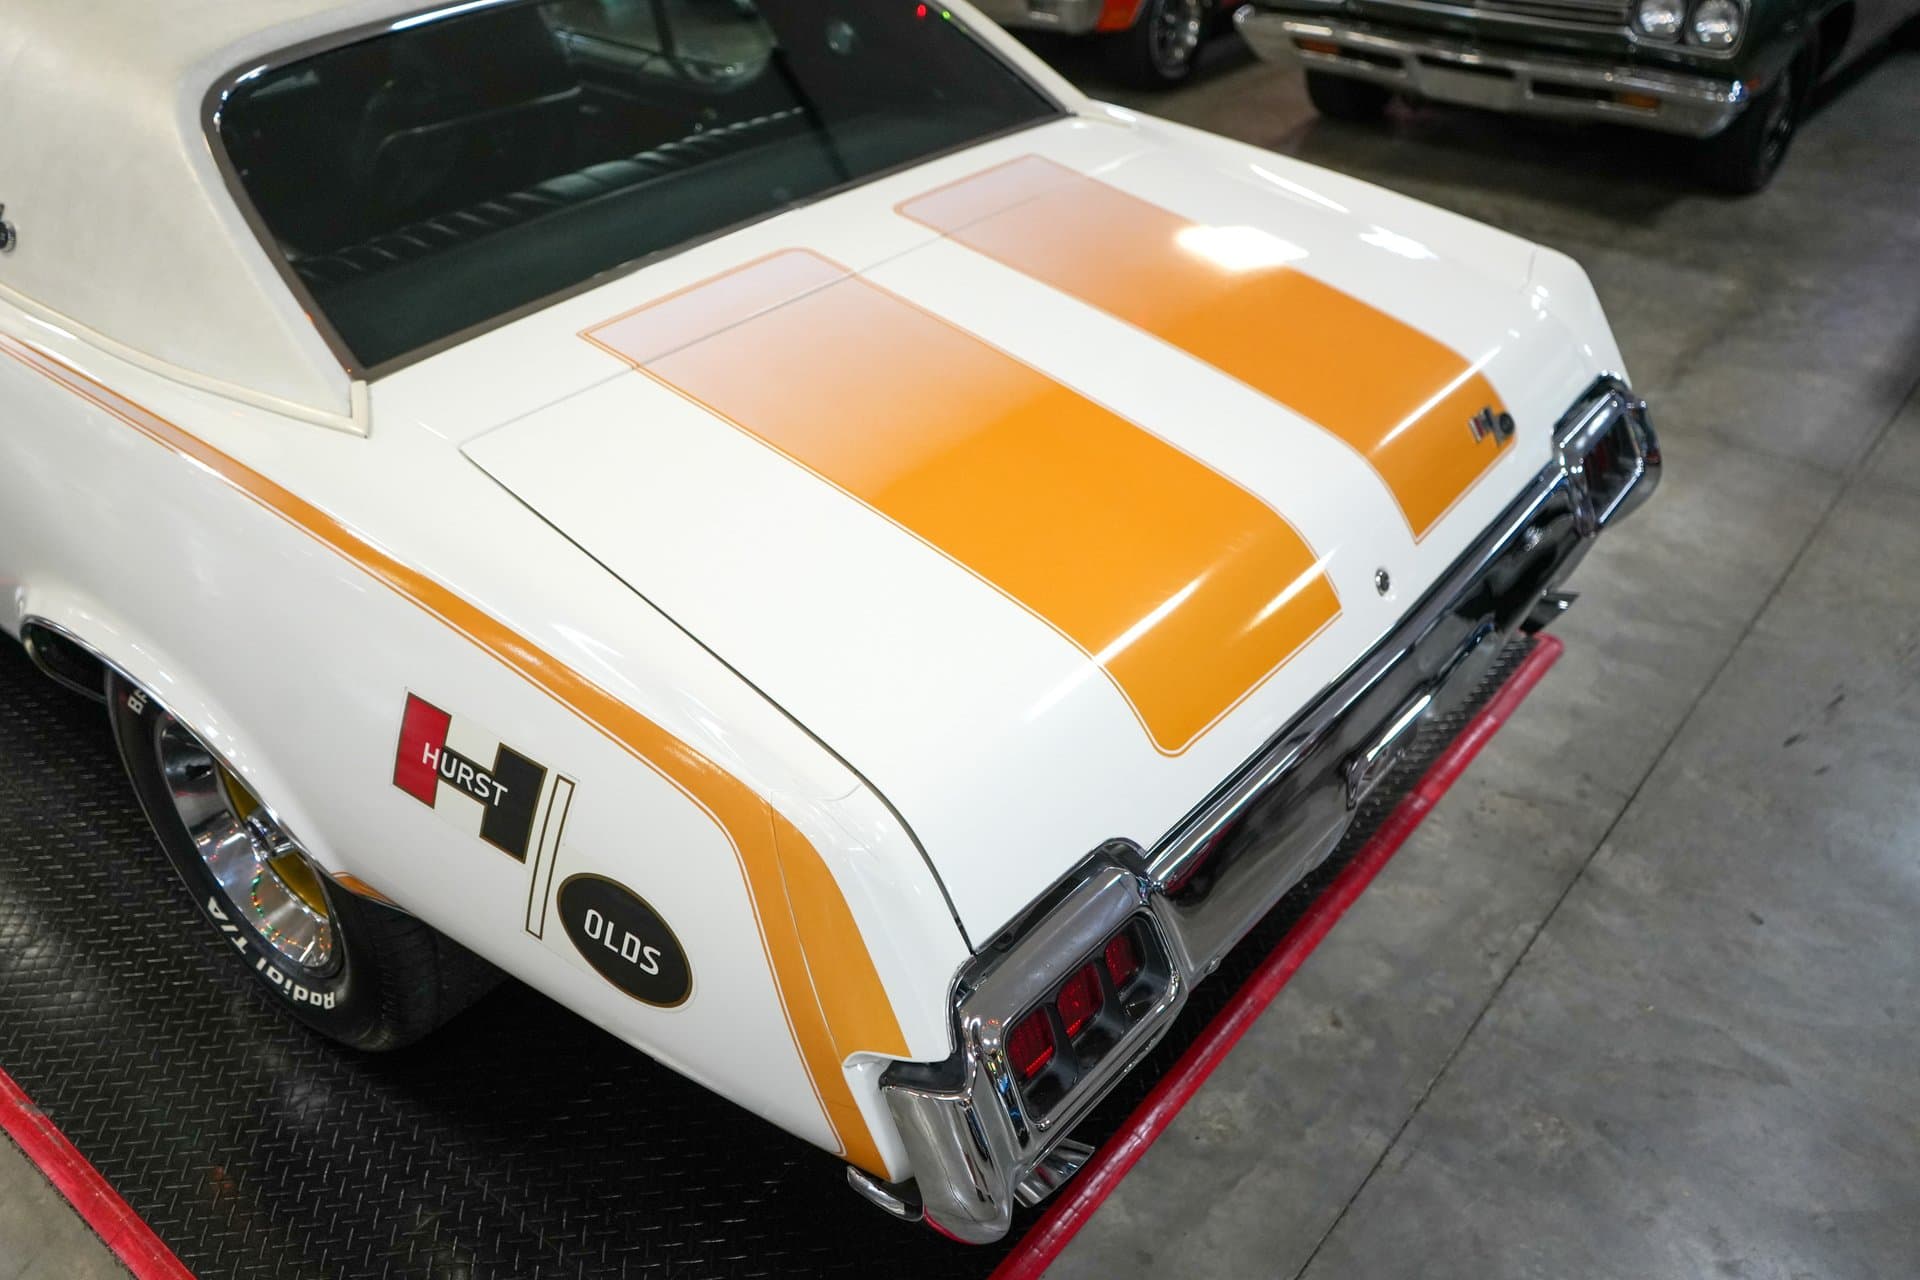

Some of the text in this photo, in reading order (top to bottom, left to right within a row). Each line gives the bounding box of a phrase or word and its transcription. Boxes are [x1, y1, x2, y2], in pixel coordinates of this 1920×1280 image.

[422, 741, 508, 807] HURST
[207, 896, 335, 1010] Radial T/A
[584, 908, 661, 976] OLDS
